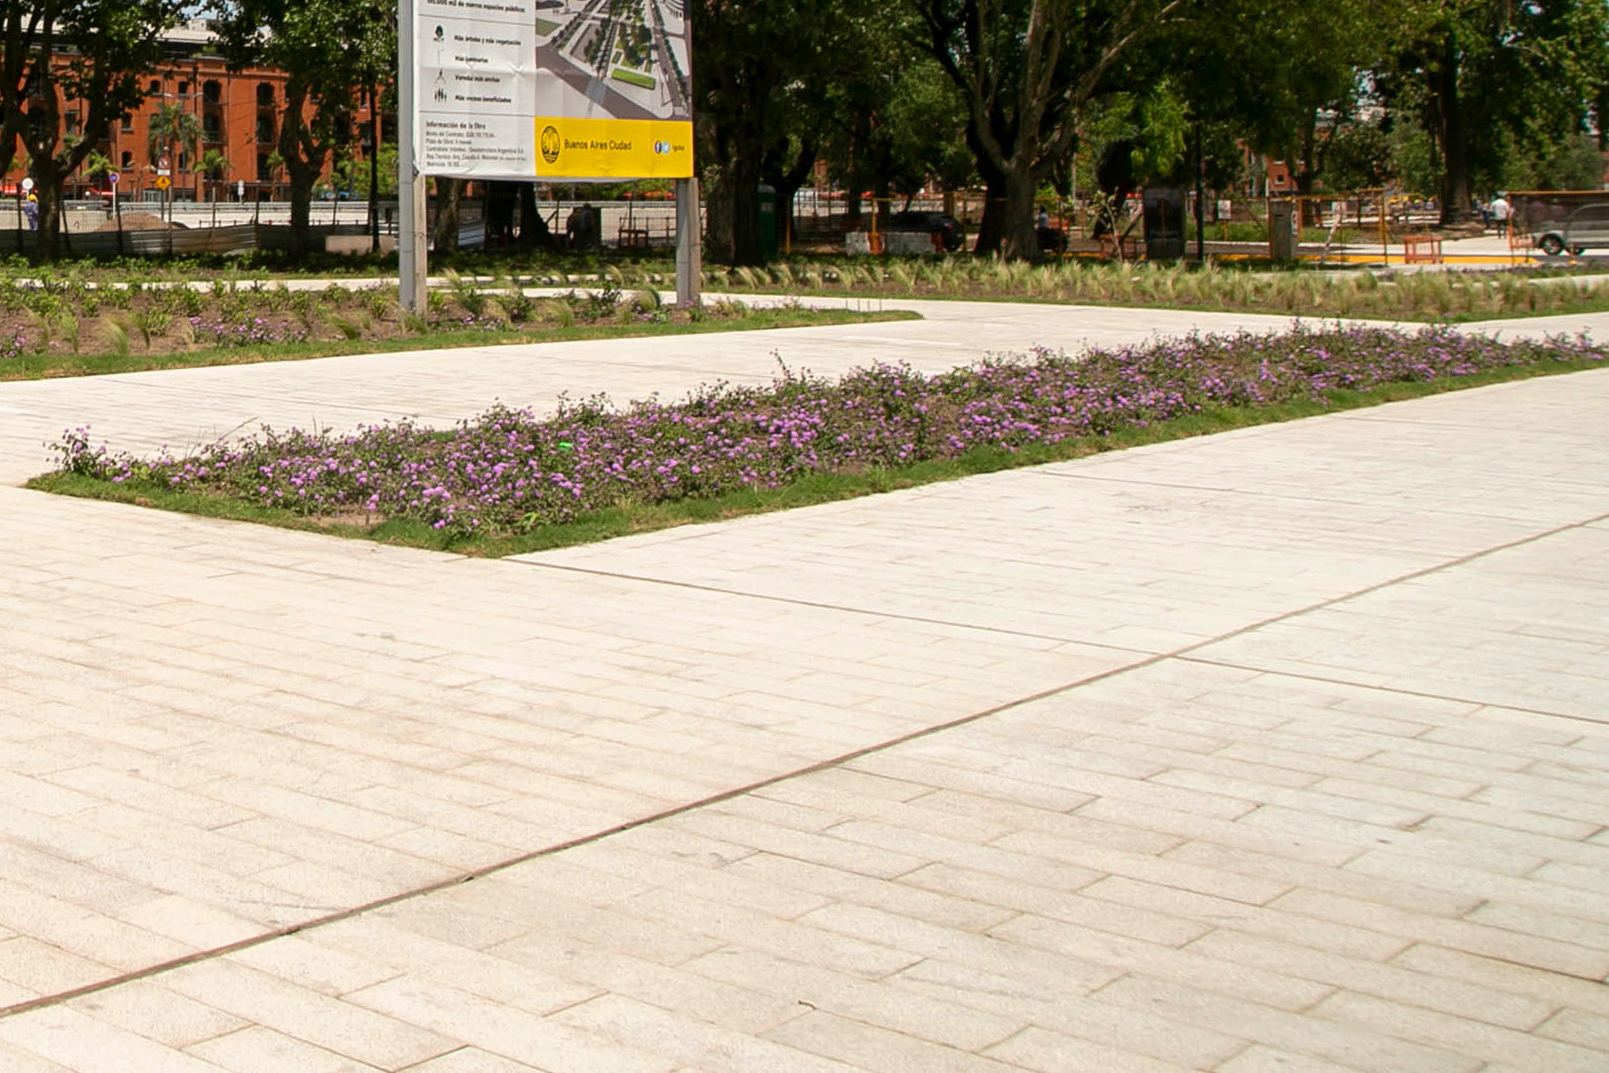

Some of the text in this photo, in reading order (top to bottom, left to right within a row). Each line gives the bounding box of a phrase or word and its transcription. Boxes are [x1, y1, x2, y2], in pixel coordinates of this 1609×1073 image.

[564, 139, 632, 151] Buenos Aires Ciudad
